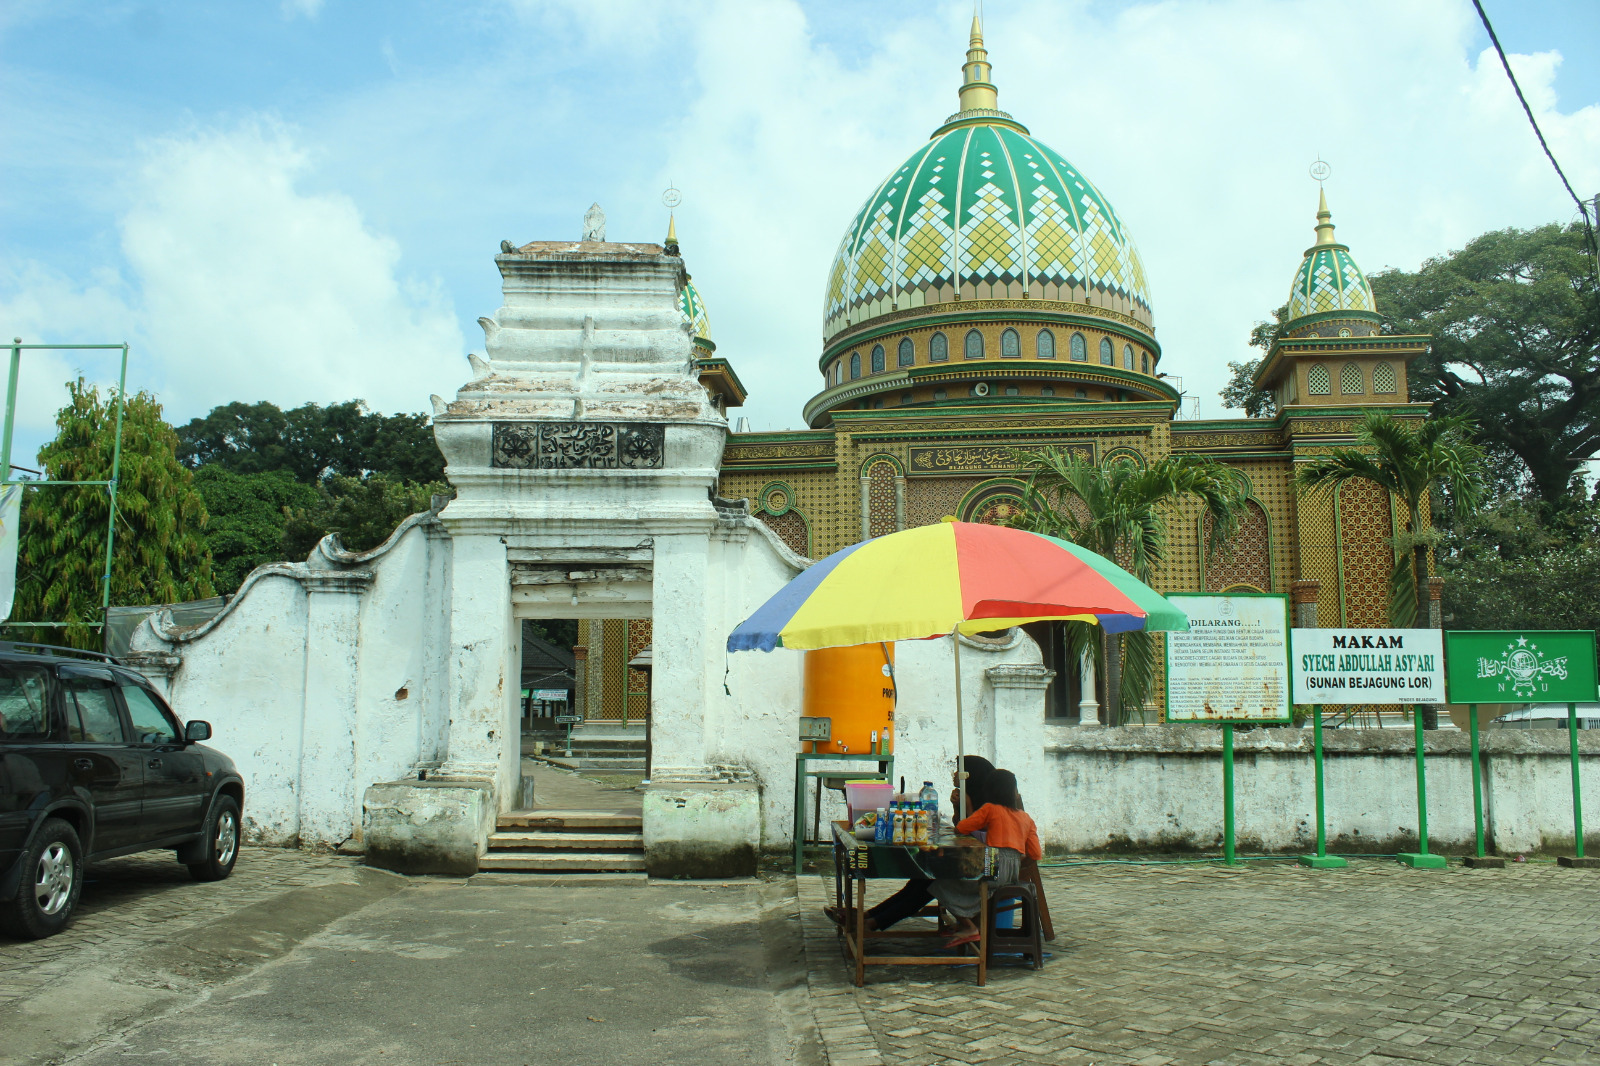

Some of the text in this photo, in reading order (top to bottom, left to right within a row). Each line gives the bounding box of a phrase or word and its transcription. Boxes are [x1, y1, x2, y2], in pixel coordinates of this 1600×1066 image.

[1332, 635, 1403, 648] MAKAM
[1302, 654, 1435, 671] SYECH ABDULLAH ASY'ARI
[1306, 676, 1432, 690] (SUNAN BEJAGUNG LOR)
[1498, 683, 1548, 692] N U
[882, 688, 895, 699] PROF
[857, 852, 868, 869] WIB
